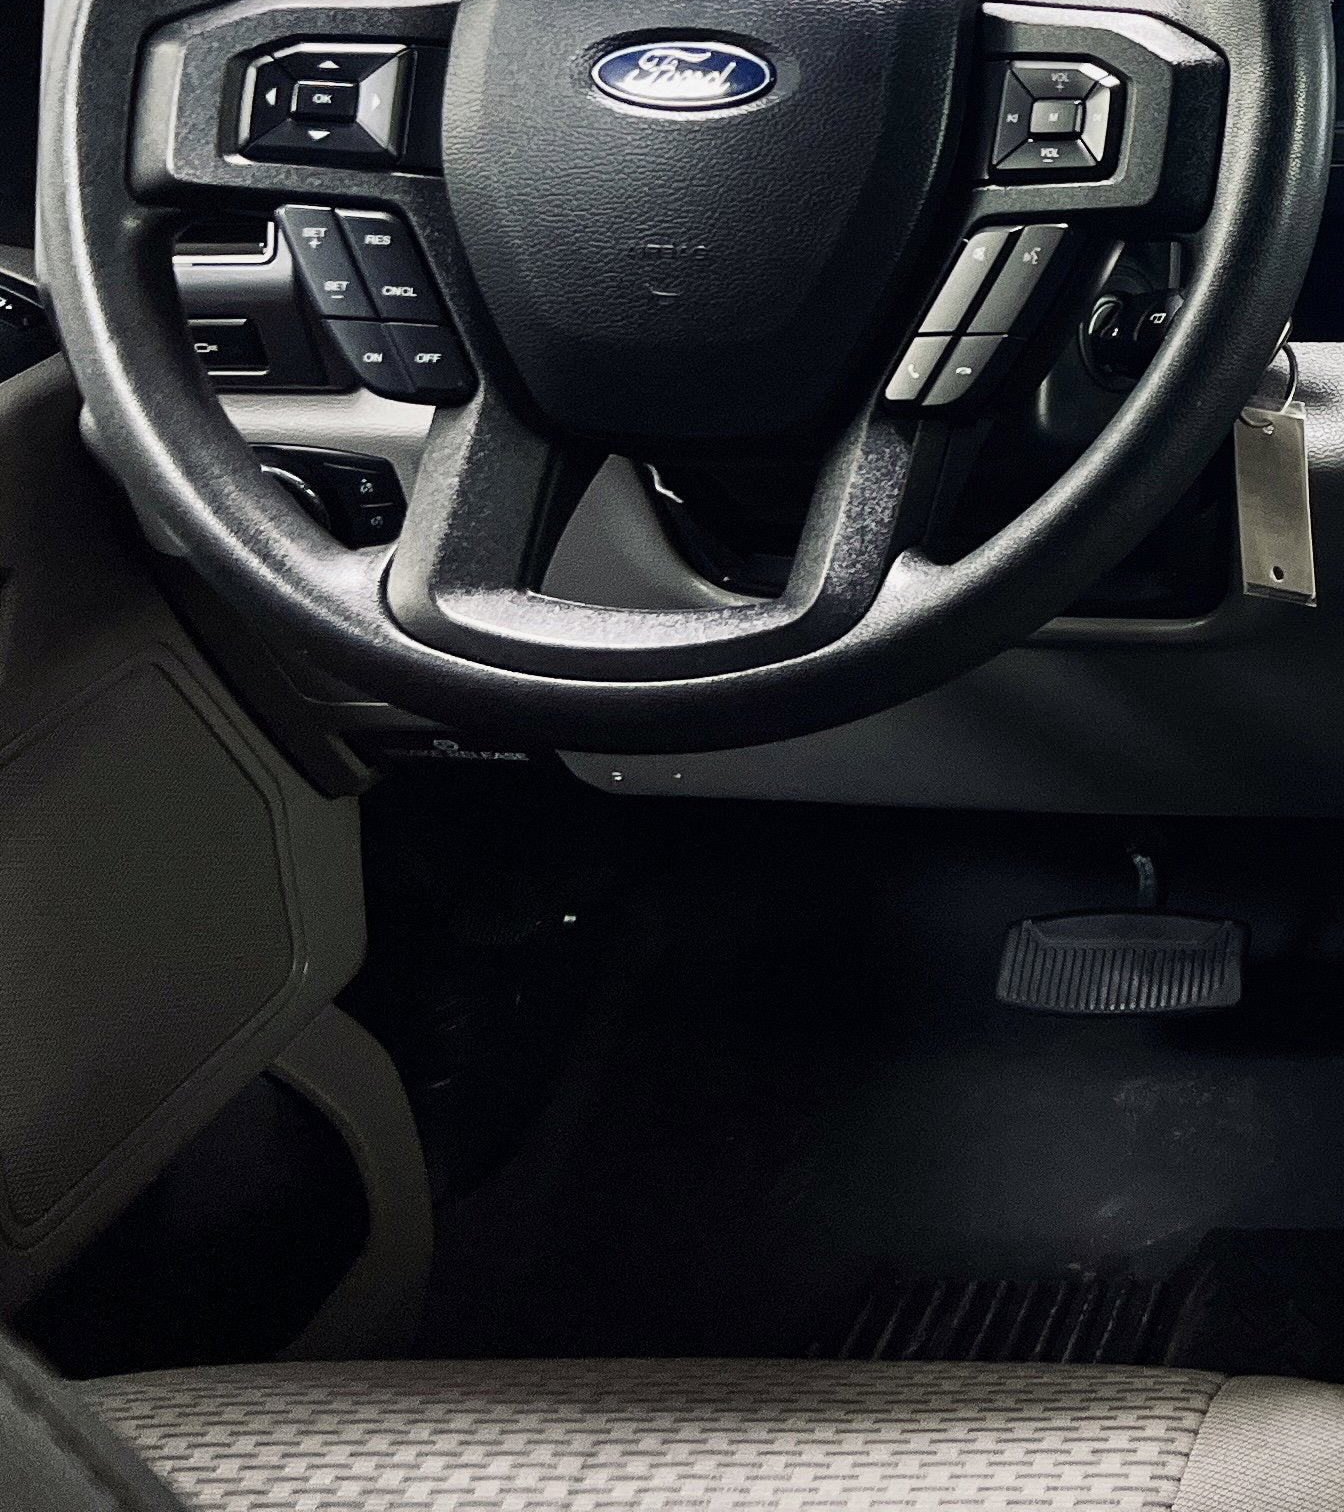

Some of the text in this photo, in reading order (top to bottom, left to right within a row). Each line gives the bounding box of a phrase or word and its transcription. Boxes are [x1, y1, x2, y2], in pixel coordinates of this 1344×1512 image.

[615, 48, 737, 100] Ford
[312, 93, 332, 104] OK
[364, 234, 391, 246] RES
[363, 353, 384, 363] ON
[414, 353, 442, 364] OFF
